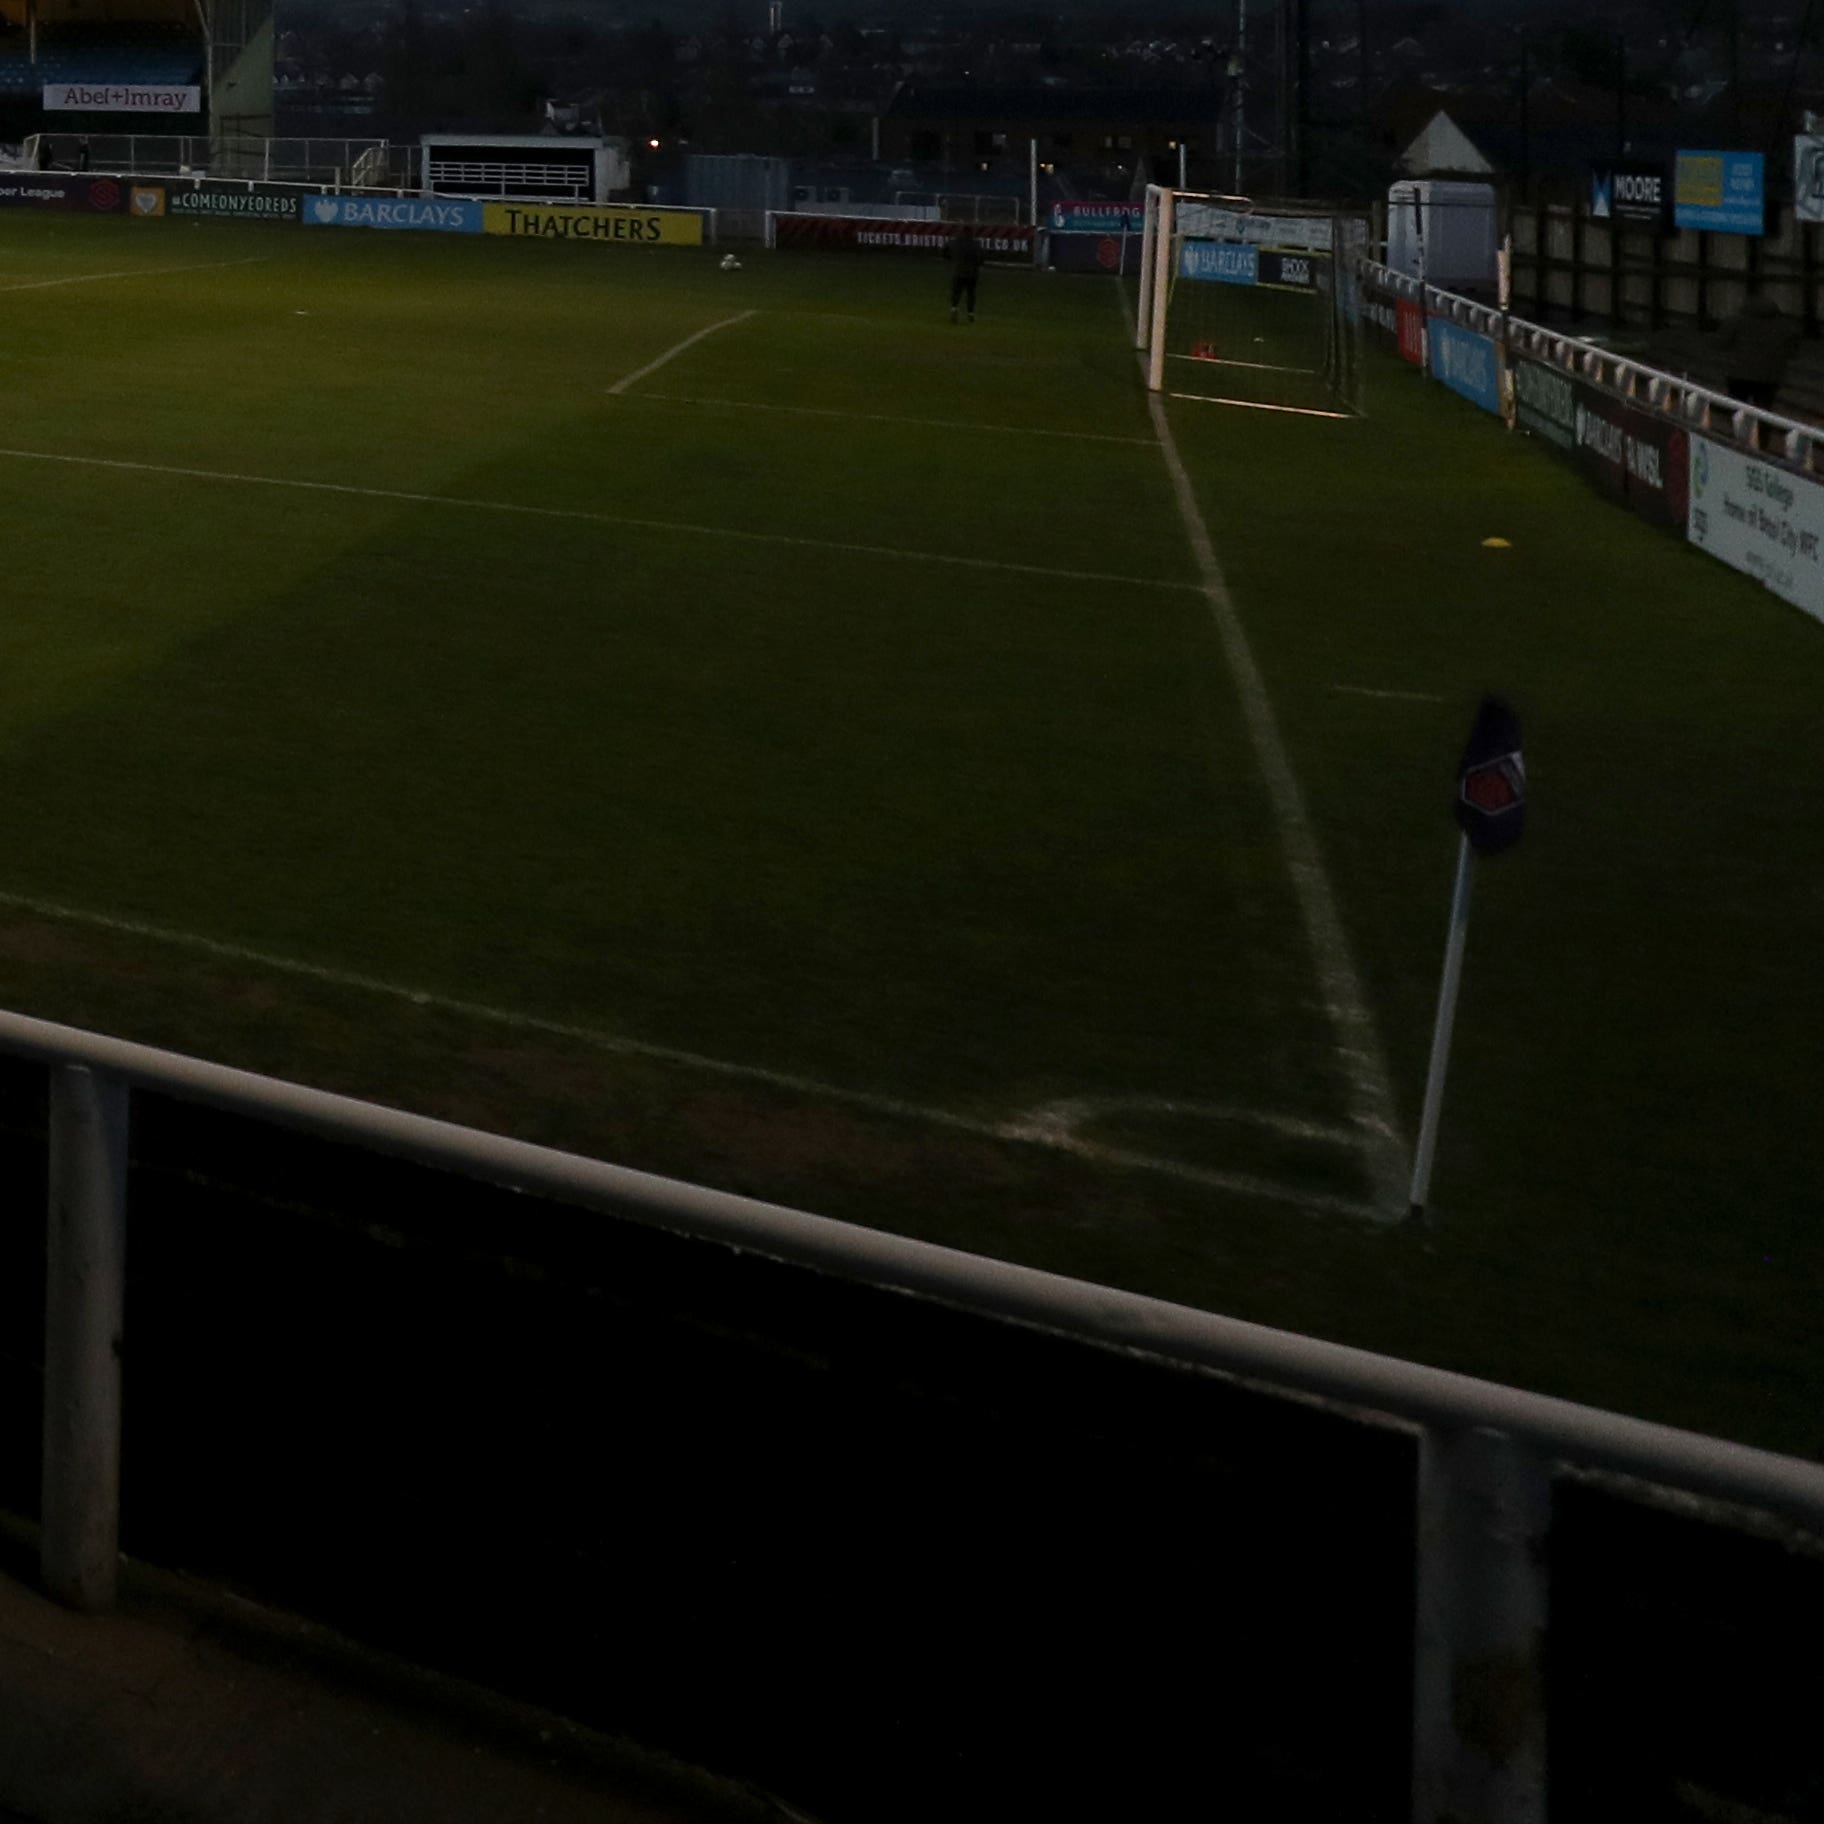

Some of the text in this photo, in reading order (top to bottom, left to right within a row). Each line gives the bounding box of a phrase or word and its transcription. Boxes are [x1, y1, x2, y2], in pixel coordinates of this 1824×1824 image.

[63, 87, 188, 111] Abel+Imray
[20, 186, 66, 201] League
[1614, 173, 1662, 203] MOORE
[343, 201, 465, 226] BARCLAYS
[1073, 205, 1141, 217] BULLFROG
[504, 208, 662, 241] THATCHERS
[1201, 247, 1257, 276] BARCLAYS
